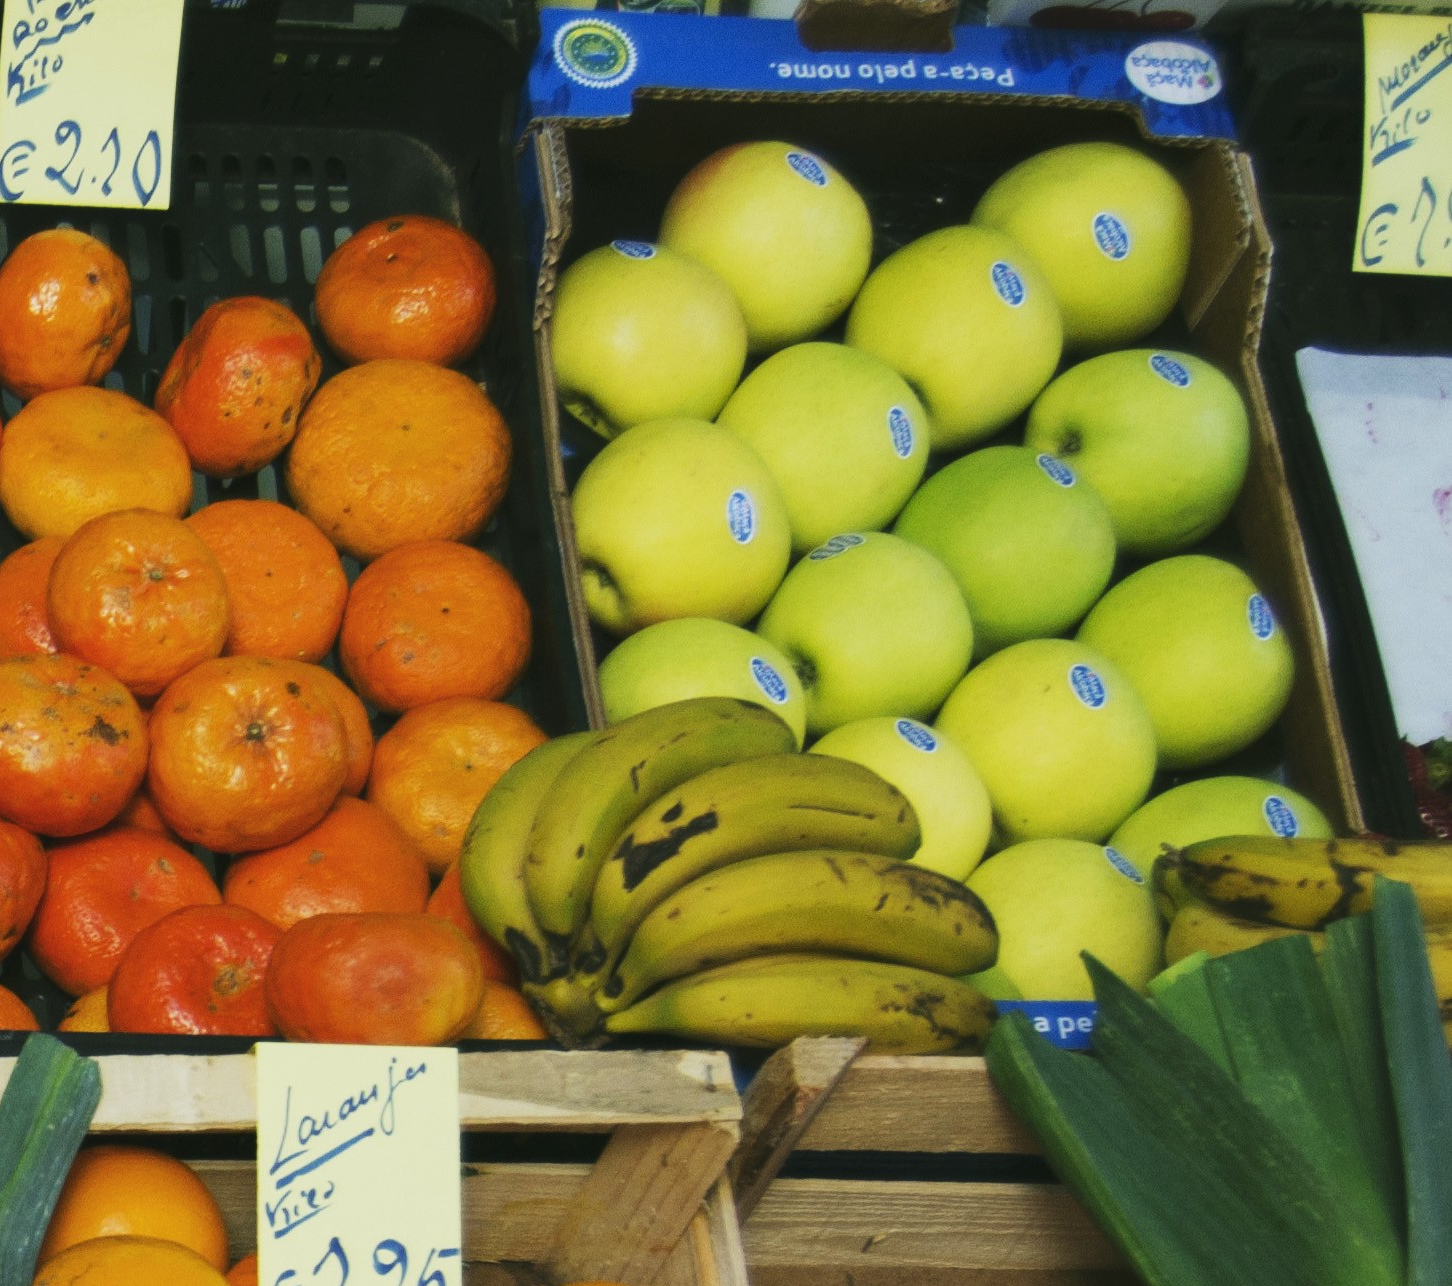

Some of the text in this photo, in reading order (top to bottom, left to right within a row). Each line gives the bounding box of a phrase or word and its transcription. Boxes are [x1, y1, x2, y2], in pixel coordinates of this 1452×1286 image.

[768, 59, 1016, 87] Peça-a pelo nome.
[1131, 54, 1211, 76] Alcobaça
[1146, 70, 1193, 90] Maçã
